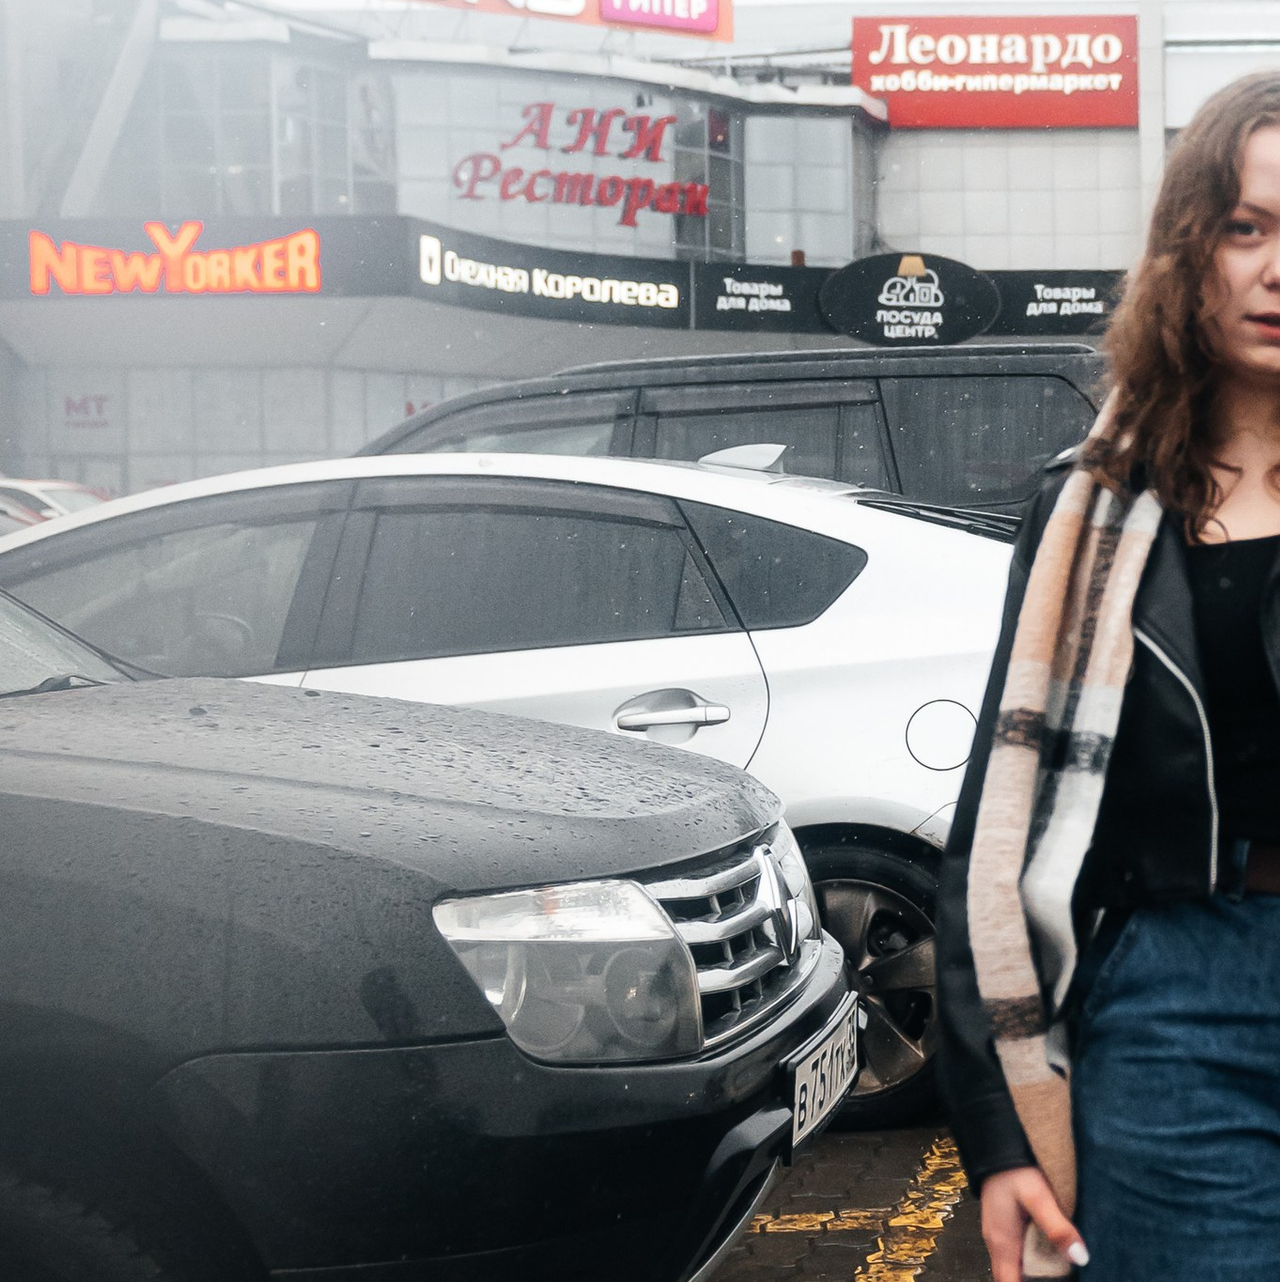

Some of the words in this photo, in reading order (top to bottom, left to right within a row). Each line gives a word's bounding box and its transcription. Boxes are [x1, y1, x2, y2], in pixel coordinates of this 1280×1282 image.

[870, 24, 1122, 71] Леонардо
[500, 101, 677, 163] АНИ
[452, 153, 710, 228] Ресторан
[532, 268, 679, 309] Королева
[723, 278, 783, 299] Товары
[1034, 284, 1095, 301] Товары
[717, 296, 746, 311] для
[748, 297, 791, 312] дома
[1026, 301, 1057, 316] для
[1060, 301, 1103, 316] дома
[876, 310, 943, 325] ПОСУДА
[884, 325, 936, 339] ЦЕНТР
